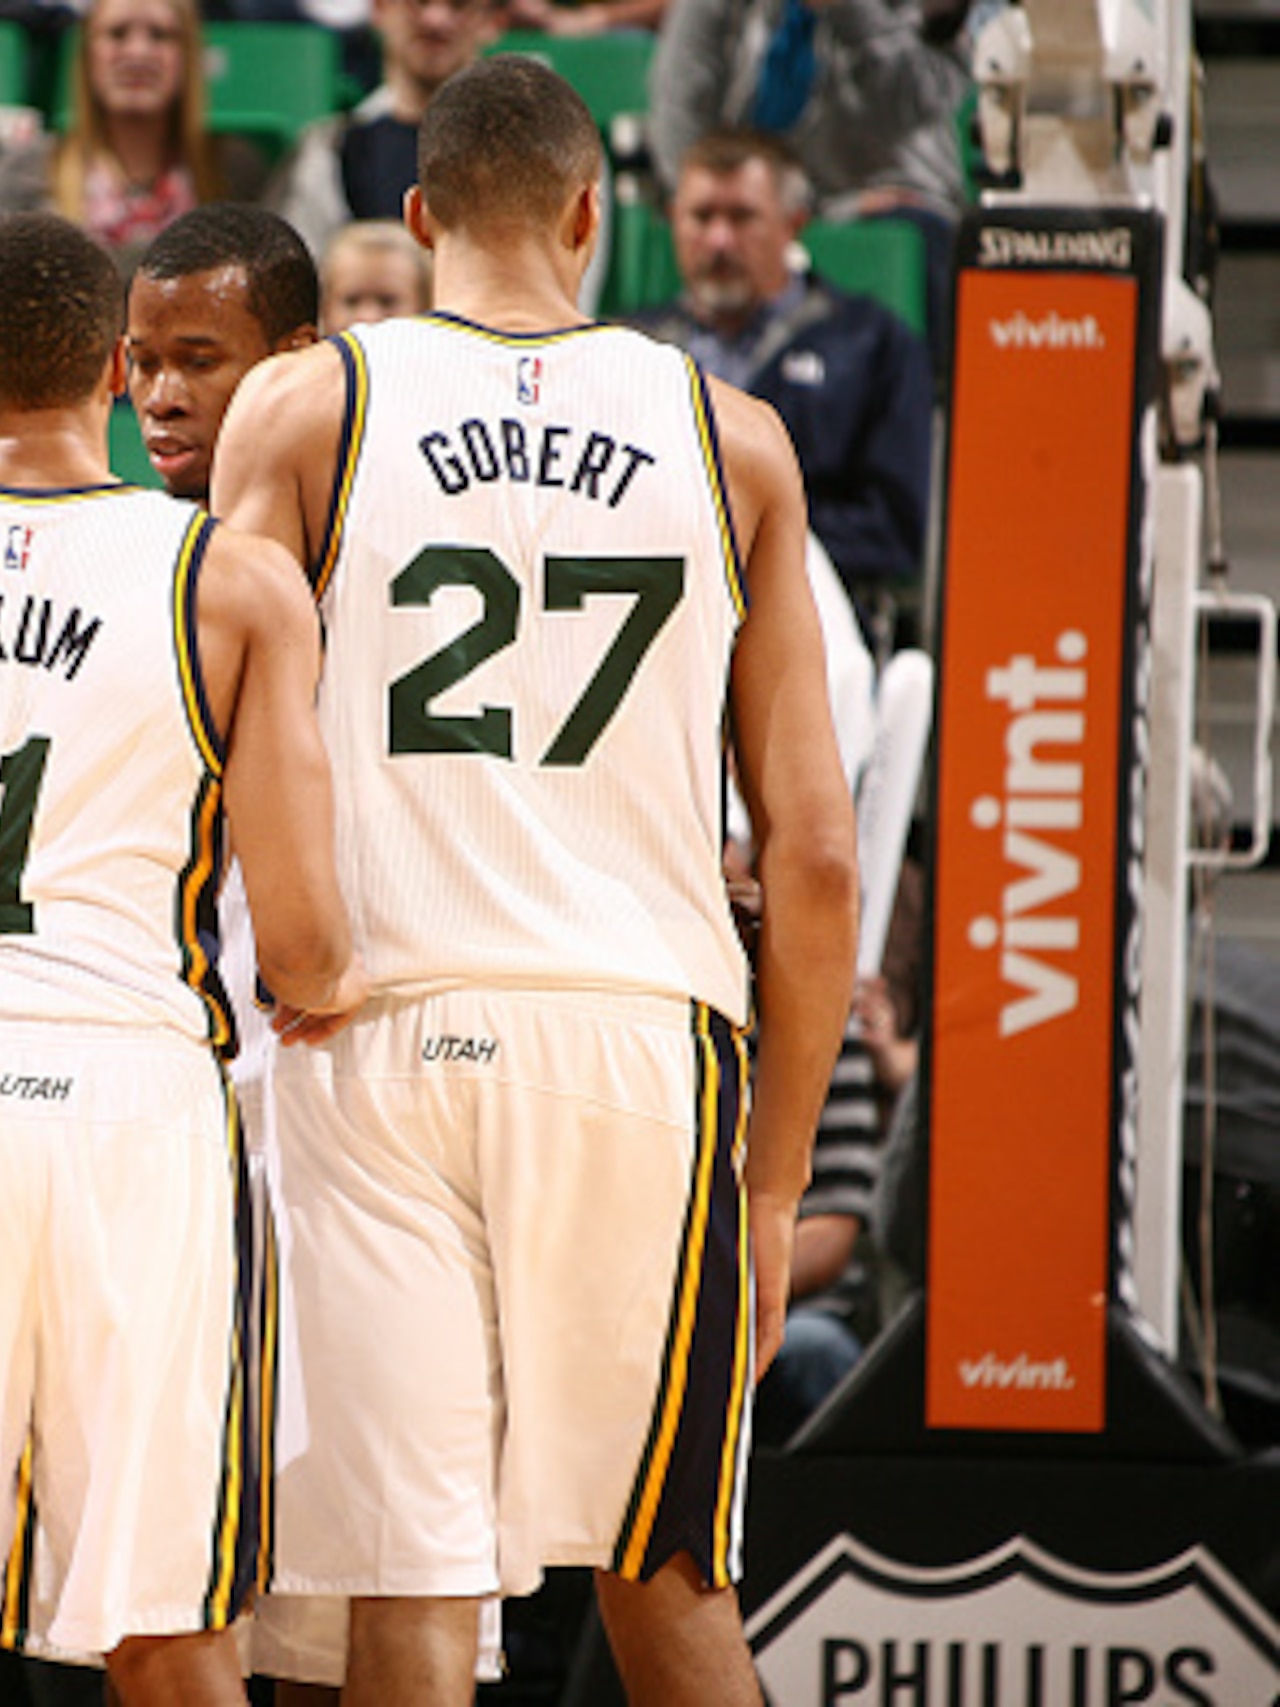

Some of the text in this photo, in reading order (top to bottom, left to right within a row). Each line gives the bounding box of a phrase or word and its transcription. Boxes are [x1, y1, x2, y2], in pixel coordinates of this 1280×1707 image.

[977, 226, 1132, 268] SPALDING
[988, 311, 1107, 349] vivint.
[419, 417, 655, 508] GOBERT
[388, 544, 685, 766] 27
[967, 629, 1088, 1039] vivint.
[421, 1035, 497, 1066] UTAH
[958, 1351, 1075, 1391] vivint.
[822, 1638, 1216, 1707] PHILLIPS
